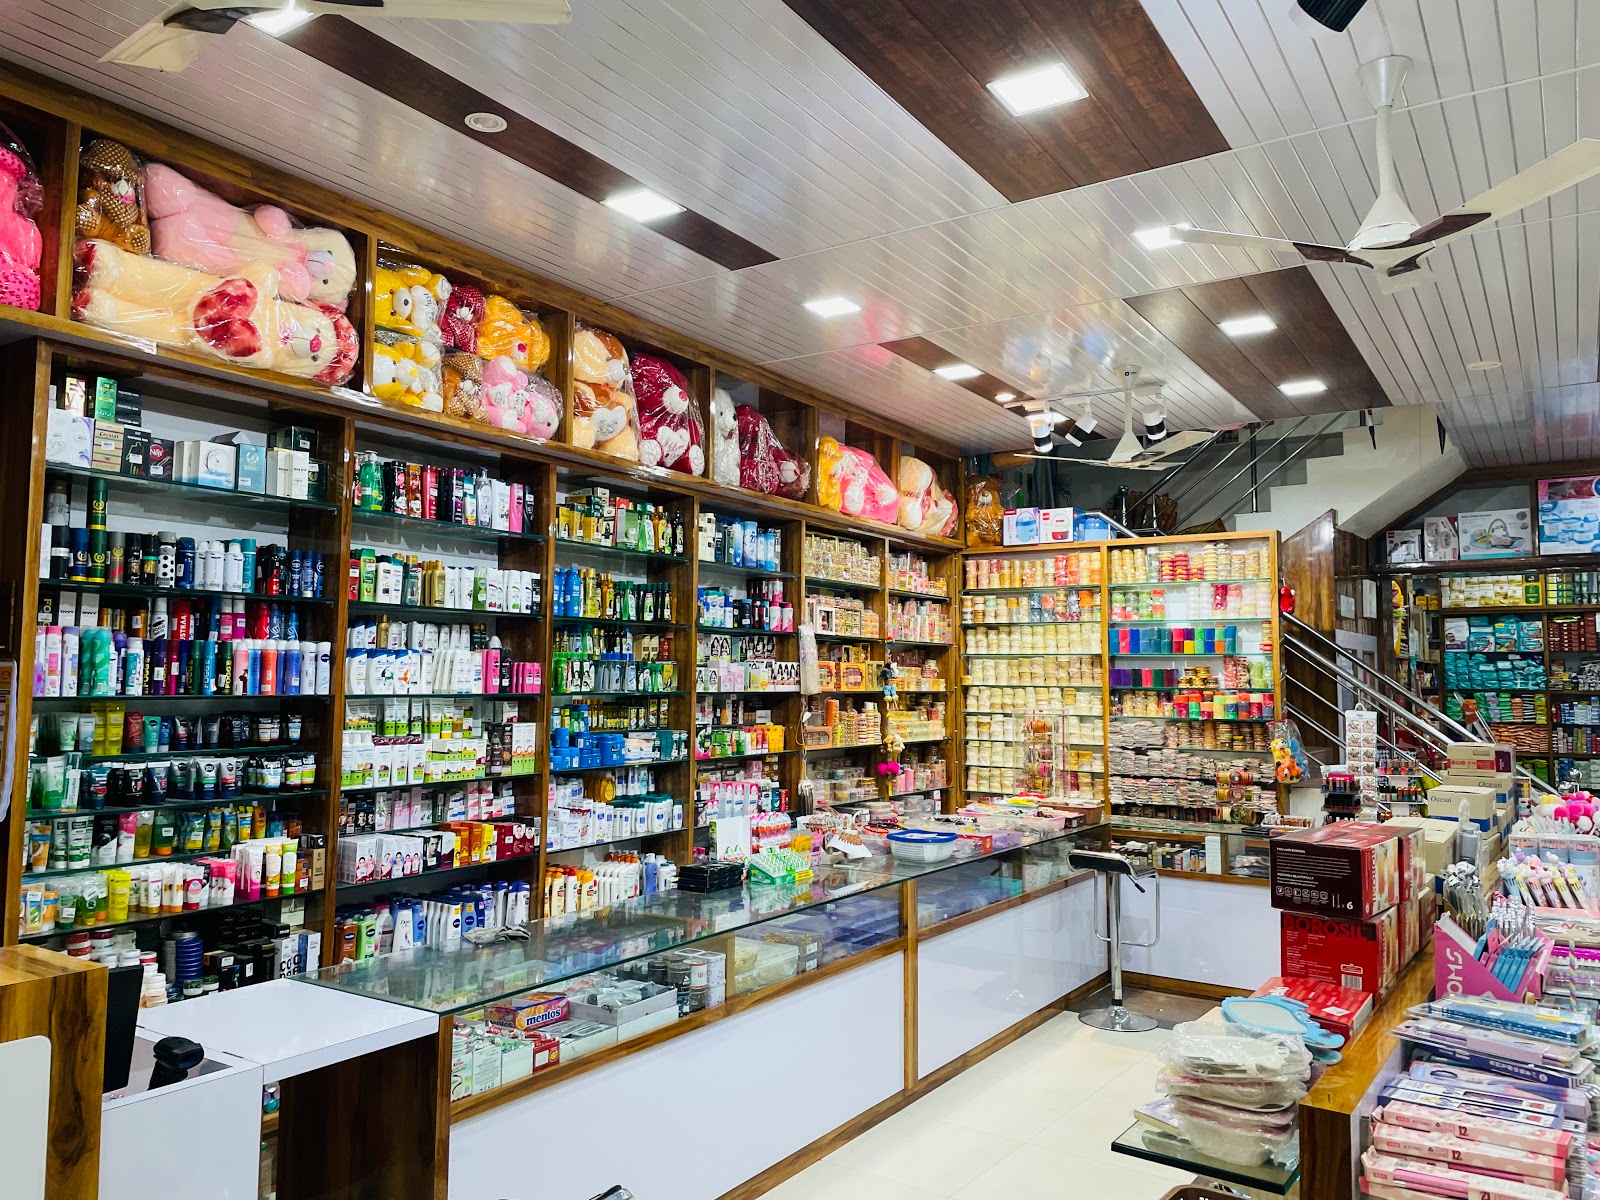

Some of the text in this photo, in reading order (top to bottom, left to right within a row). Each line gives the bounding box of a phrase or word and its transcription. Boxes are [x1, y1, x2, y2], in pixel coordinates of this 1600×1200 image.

[99, 431, 119, 440] Crystal
[1478, 781, 1503, 789] Ocean
[1430, 795, 1452, 803] Ocean
[1346, 902, 1354, 910] 6
[1283, 915, 1368, 940] BOROSIL
[1446, 947, 1464, 996] OMS
[526, 1008, 561, 1026] mentos
